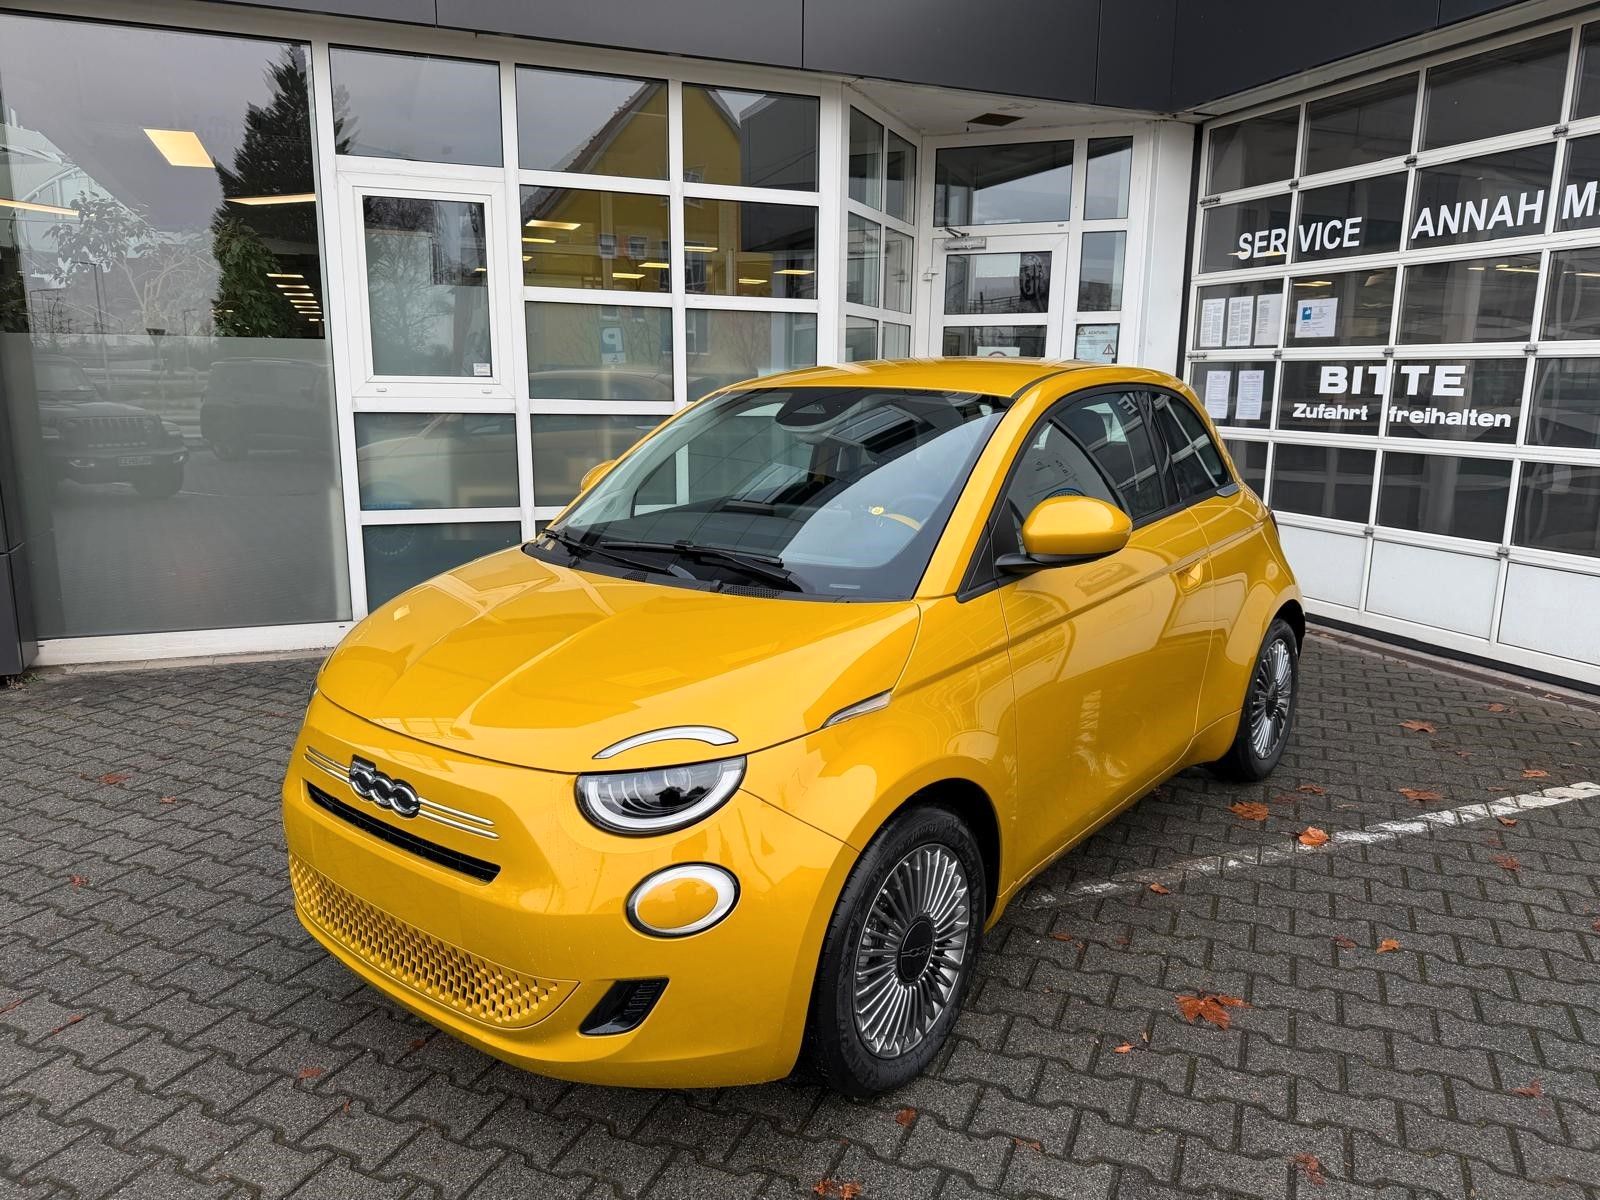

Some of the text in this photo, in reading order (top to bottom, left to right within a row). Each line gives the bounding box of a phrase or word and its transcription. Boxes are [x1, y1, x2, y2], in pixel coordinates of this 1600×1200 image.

[1238, 180, 1600, 260] SERVICE ANNAHM
[1319, 365, 1466, 397] BITTE
[1293, 403, 1512, 428] Zufahrt freihalten
[350, 754, 419, 819] 500
